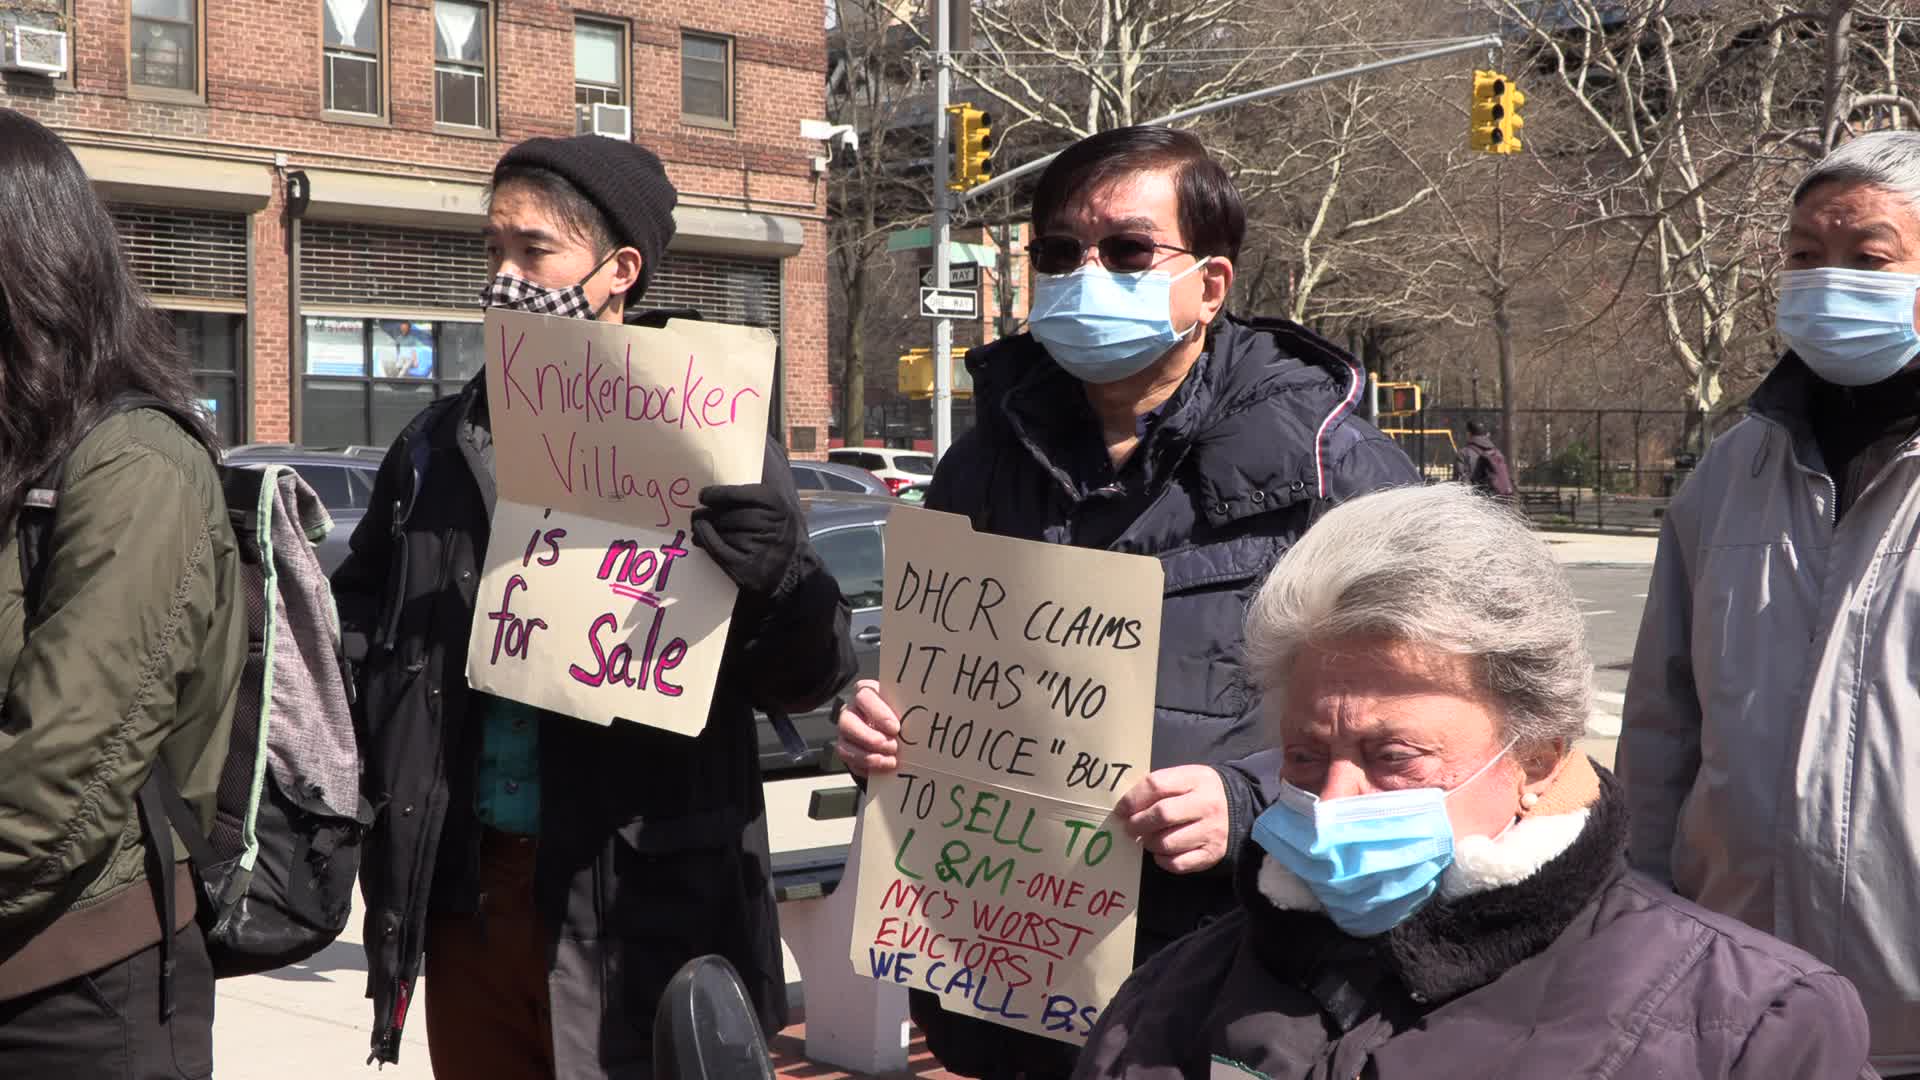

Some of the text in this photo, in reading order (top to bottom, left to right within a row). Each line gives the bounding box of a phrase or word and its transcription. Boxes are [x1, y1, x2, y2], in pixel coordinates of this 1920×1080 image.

[952, 271, 970, 281] WAY
[501, 324, 760, 430] Knickerbocker
[542, 431, 695, 527] Village
[522, 507, 689, 592] is not
[488, 574, 689, 697] for Sale
[895, 561, 1142, 650] DHCR CLAIMS
[896, 641, 1107, 719] IT HAS "NO
[1066, 752, 1132, 792] BUT
[897, 773, 1113, 867] TO SELL TO
[973, 900, 1094, 957] WORST
[1087, 889, 1126, 917] OF
[869, 947, 917, 984] WE
[925, 961, 1029, 1019] CALL
